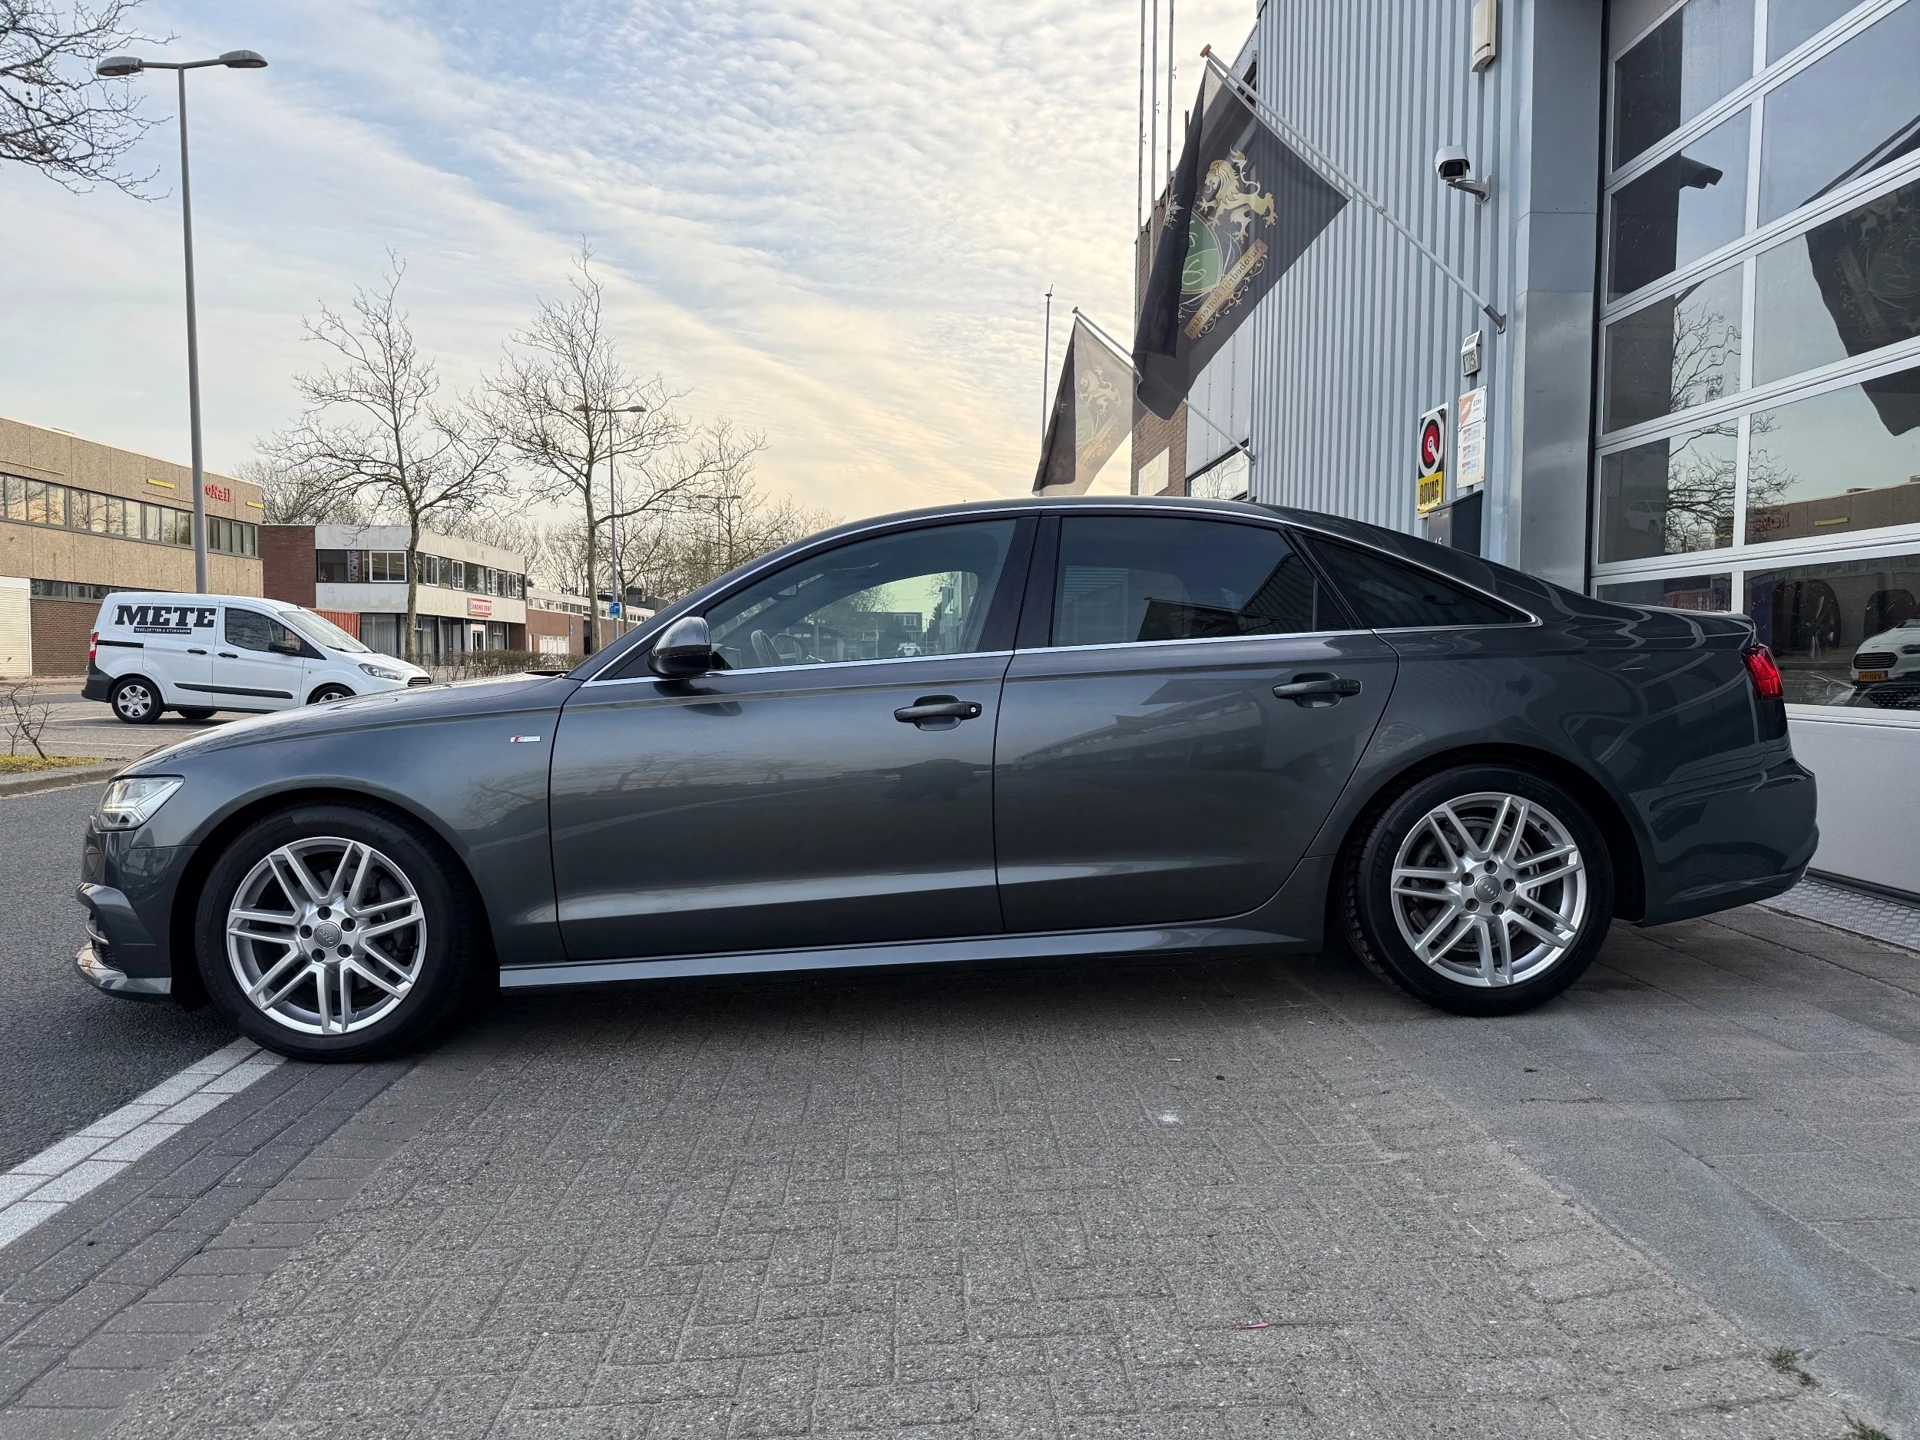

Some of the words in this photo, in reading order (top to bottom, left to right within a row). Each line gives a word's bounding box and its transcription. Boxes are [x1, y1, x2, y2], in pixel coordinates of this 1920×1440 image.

[204, 484, 231, 503] oRail
[1419, 478, 1440, 505] BOVAG
[114, 605, 217, 628] METE
